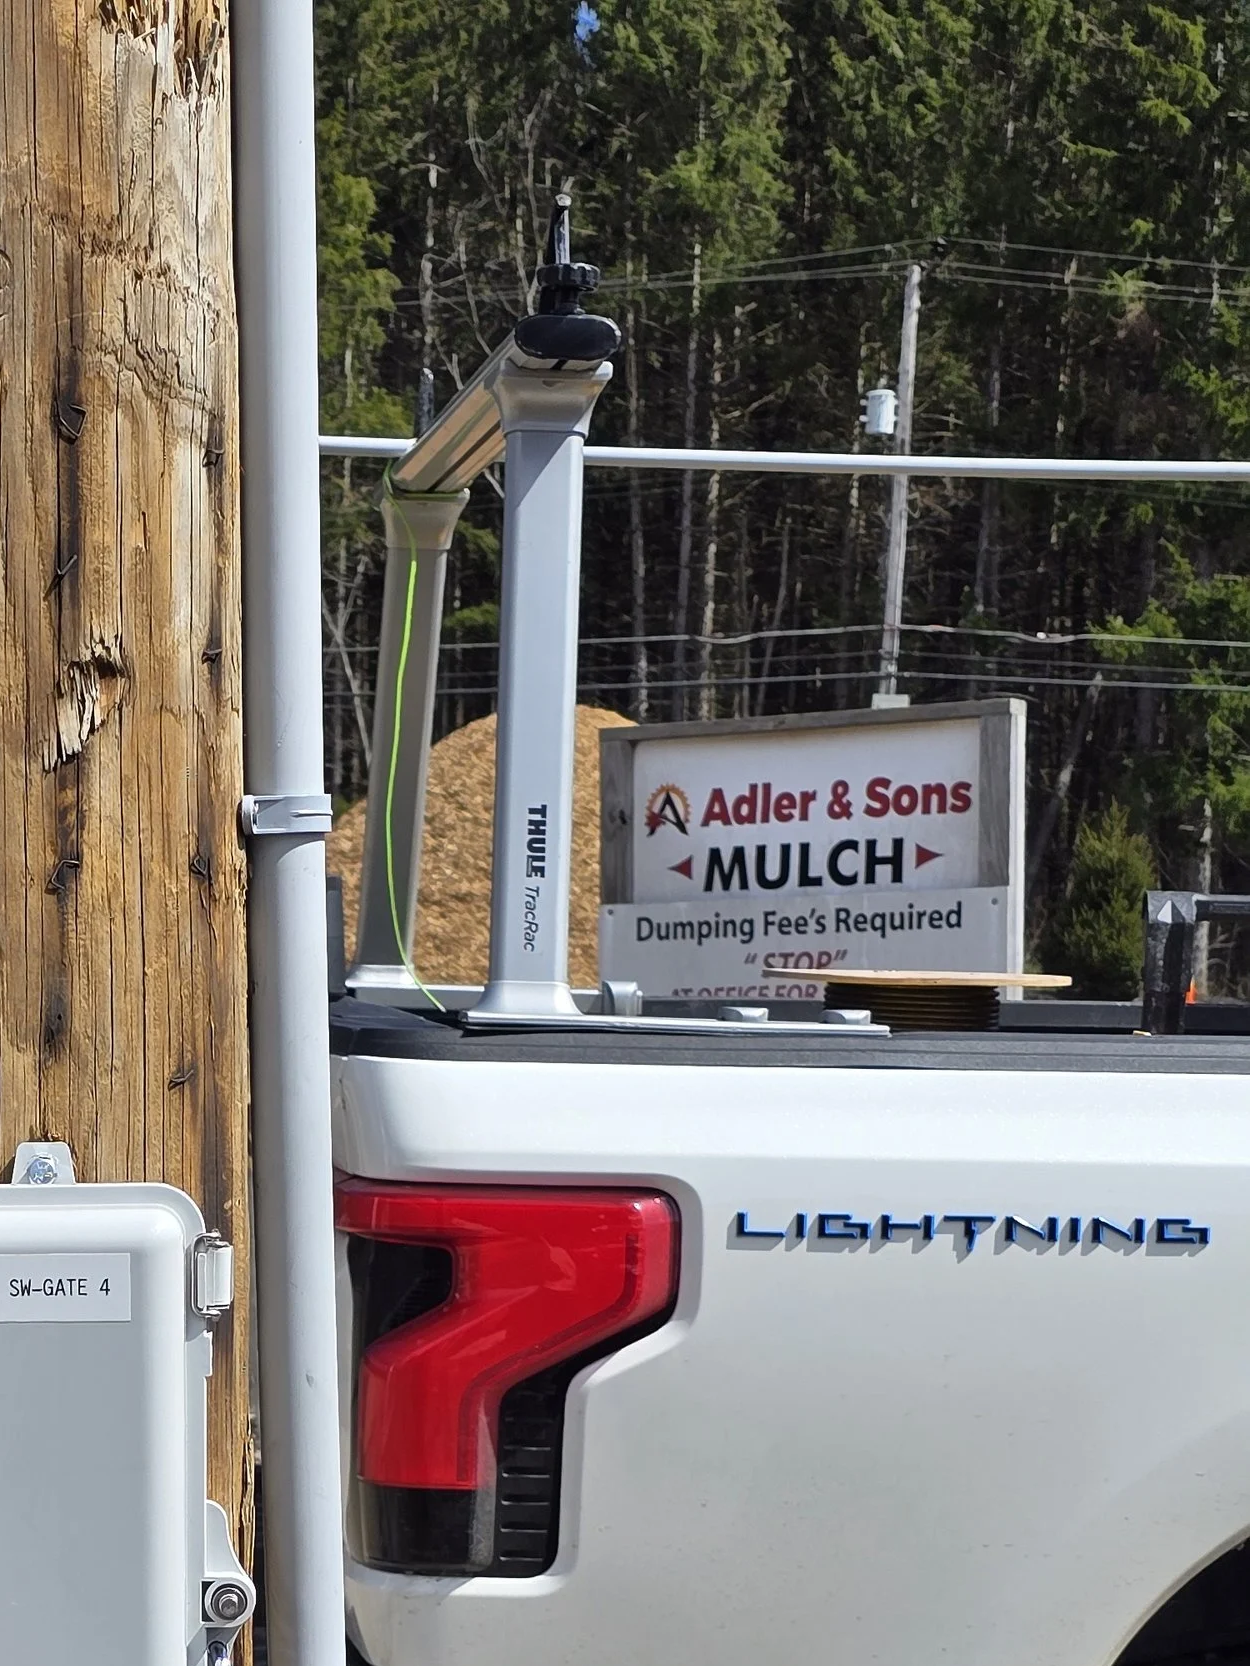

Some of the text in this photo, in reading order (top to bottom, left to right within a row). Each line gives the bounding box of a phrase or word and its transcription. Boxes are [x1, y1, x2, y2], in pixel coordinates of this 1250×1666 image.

[700, 777, 973, 827] Adler & Sons
[523, 804, 548, 952] THULE TracRac
[703, 836, 905, 892] MULCH
[636, 901, 963, 945] Dumping Fee's Required
[736, 1211, 1210, 1252] LIGHTNING
[9, 1278, 111, 1297] SW-GATE 4
